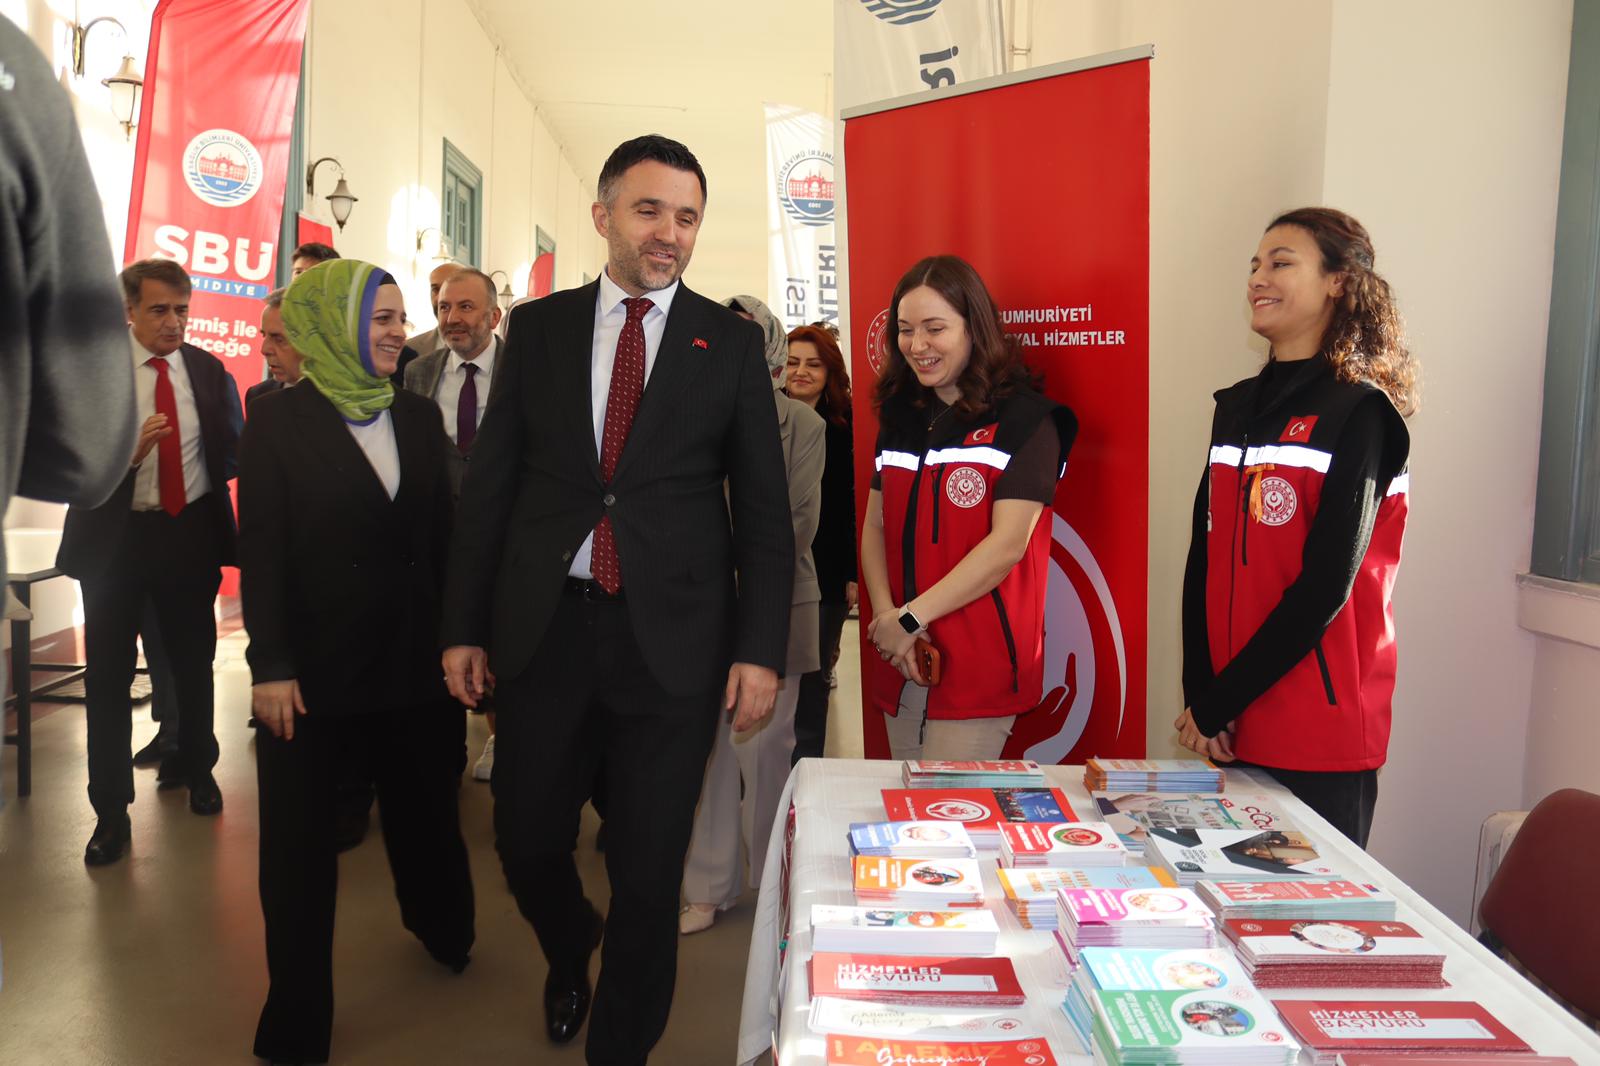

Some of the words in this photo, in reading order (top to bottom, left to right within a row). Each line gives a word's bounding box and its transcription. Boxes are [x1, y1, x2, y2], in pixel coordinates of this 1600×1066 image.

[233, 319, 258, 339] ile
[1044, 328, 1125, 347] HİZMETLER
[838, 963, 942, 974] HİZMETLER
[840, 974, 942, 983] BAŞVURU
[1309, 1009, 1420, 1019] HİZMETLER
[1316, 1018, 1427, 1029] BAŞVURU
